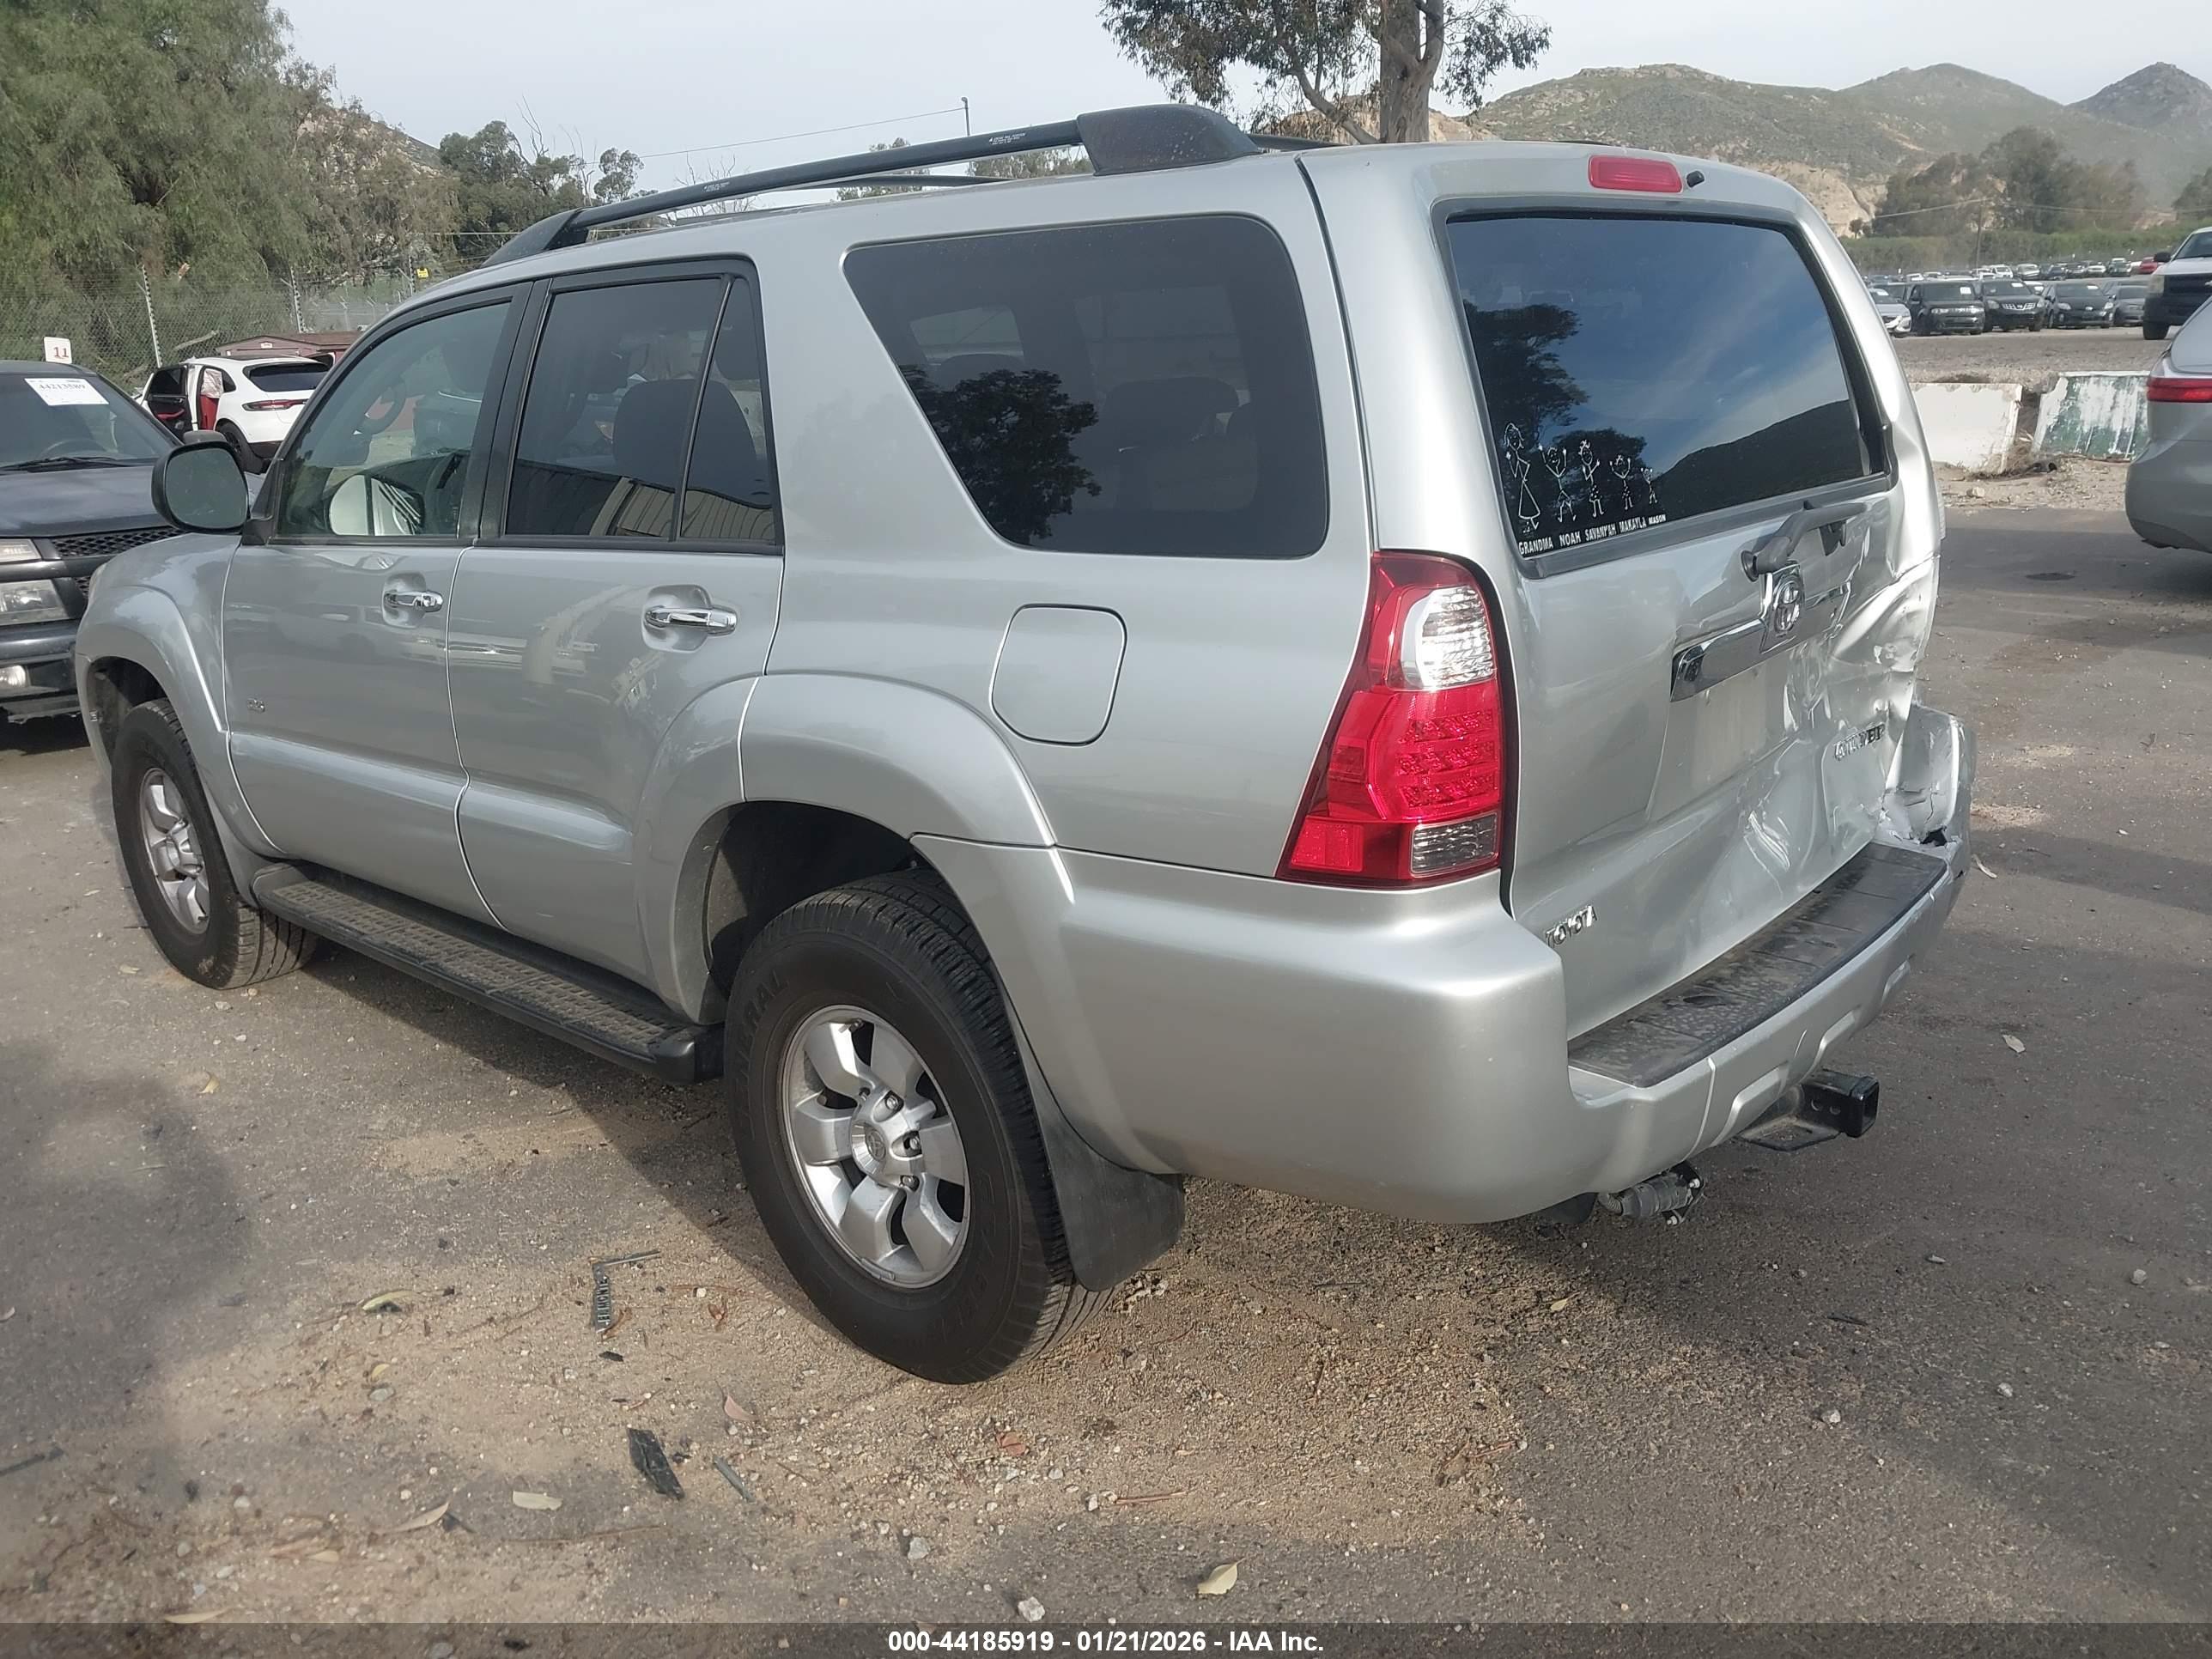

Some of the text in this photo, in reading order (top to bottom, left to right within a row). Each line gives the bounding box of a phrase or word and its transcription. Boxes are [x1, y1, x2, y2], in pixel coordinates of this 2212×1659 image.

[52, 347, 70, 358] 11
[1518, 537, 1554, 556] GRANDMA
[1559, 531, 1582, 547] NOAH
[1619, 516, 1647, 533] MAKAYLA
[1648, 514, 1667, 525] MASON
[1545, 904, 1598, 949] TOYOTA
